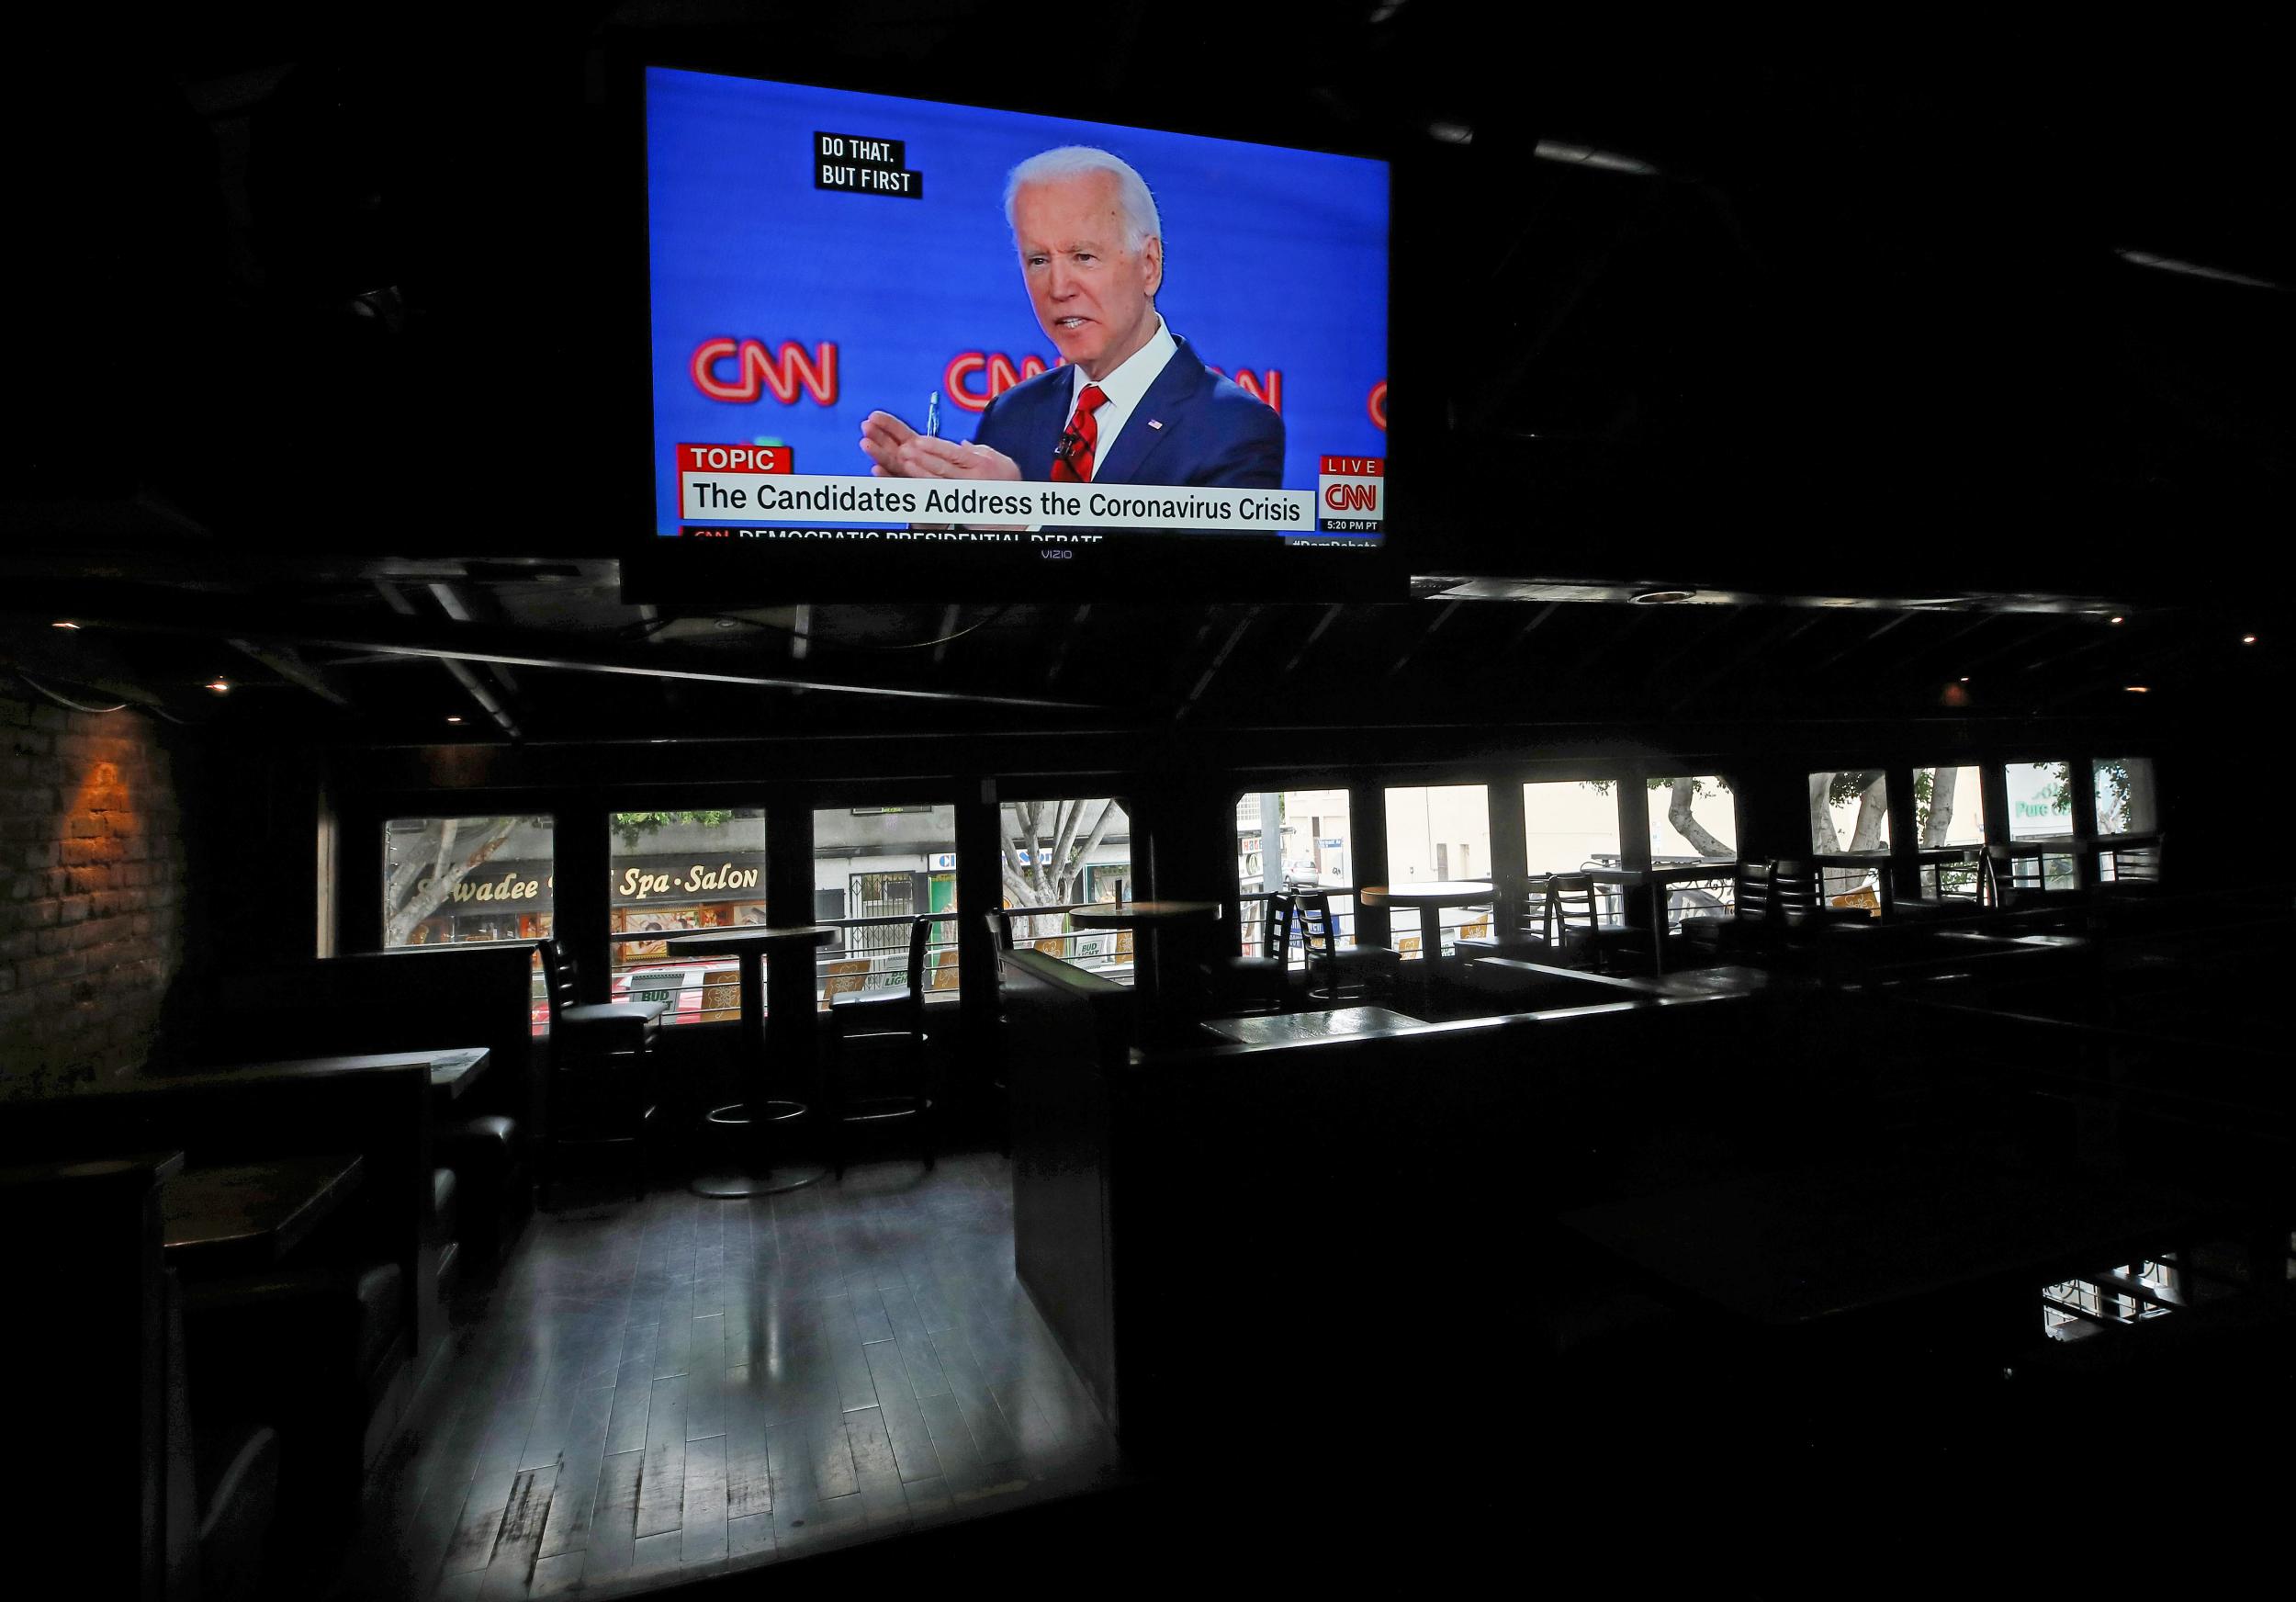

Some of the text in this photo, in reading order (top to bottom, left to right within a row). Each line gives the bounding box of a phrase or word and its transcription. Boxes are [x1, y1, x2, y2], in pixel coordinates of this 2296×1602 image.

[822, 136, 895, 163] DO THAT.
[823, 164, 911, 192] BUT FIRST
[690, 337, 839, 407] CNN
[690, 447, 775, 470] TOPIC
[1328, 458, 1376, 474] LIVE
[692, 482, 1300, 521] The Candidates Address the Coronavirus Crisis
[1325, 483, 1377, 512] CNN
[1327, 520, 1378, 531] 5:20 PM PT
[1041, 549, 1073, 559] VIZIO
[619, 867, 670, 900] Spa
[1081, 942, 1097, 952] BUD
[884, 976, 907, 987] LIGH
[641, 989, 670, 1002] BUD
